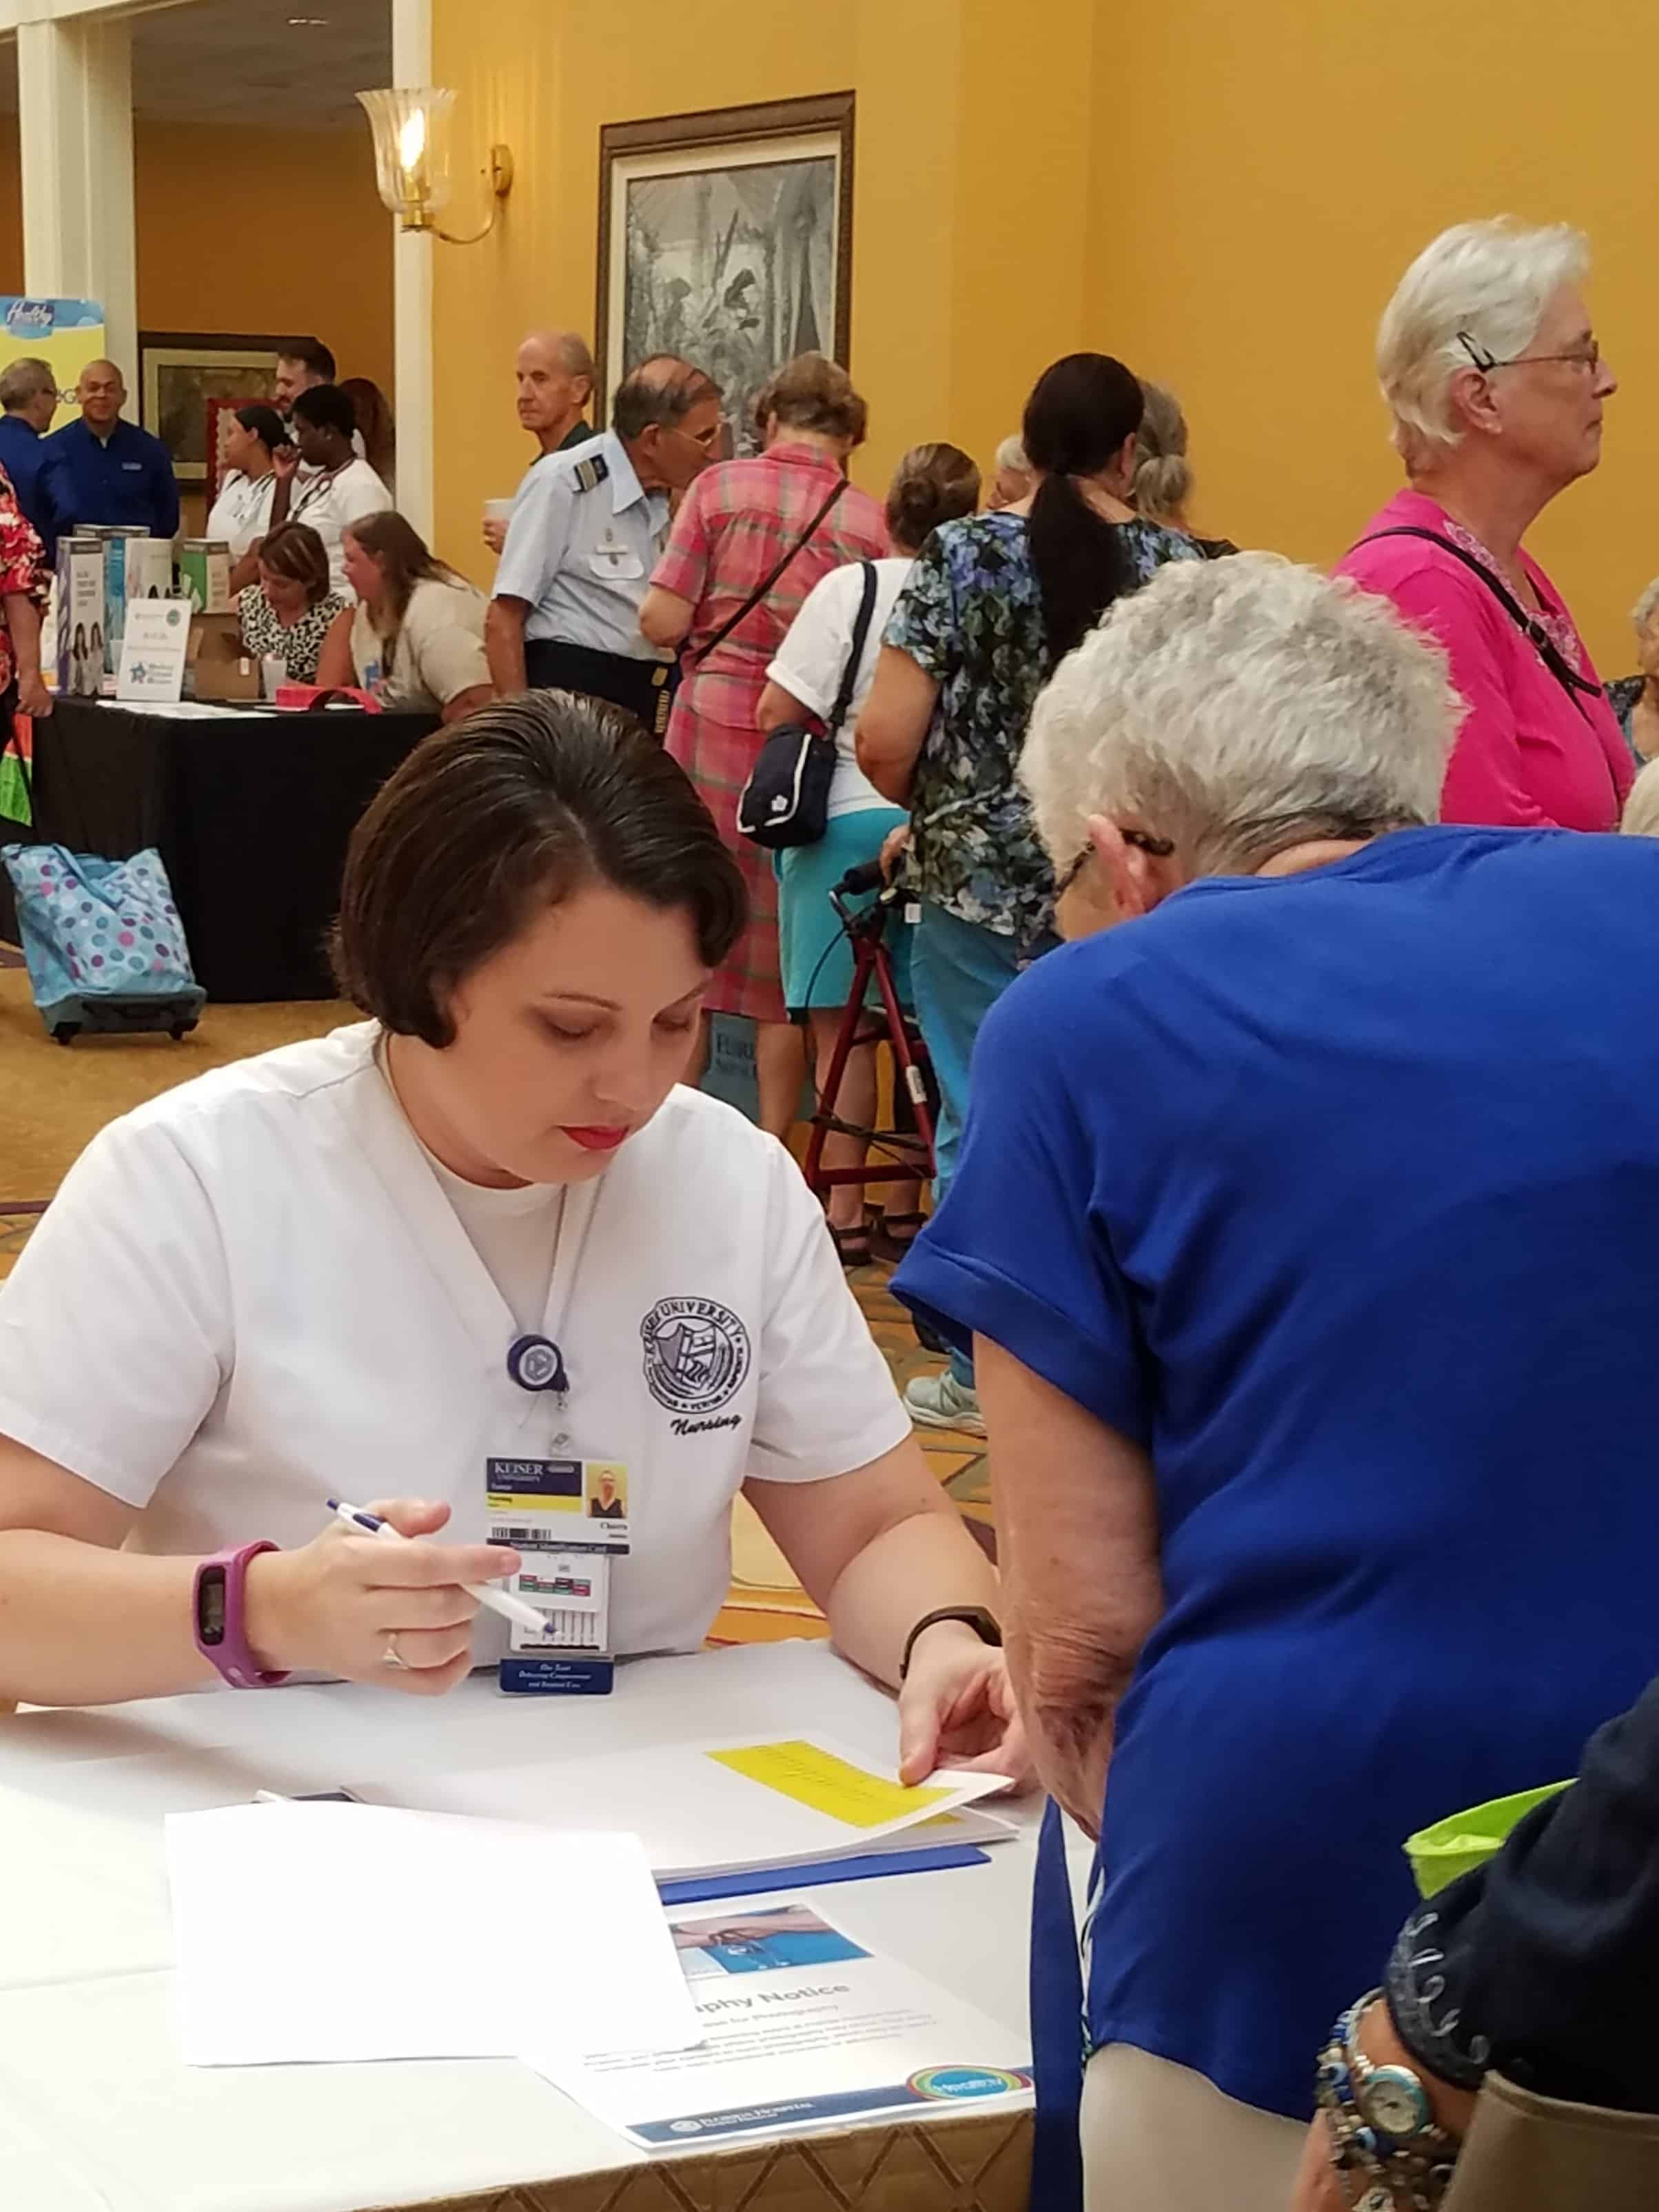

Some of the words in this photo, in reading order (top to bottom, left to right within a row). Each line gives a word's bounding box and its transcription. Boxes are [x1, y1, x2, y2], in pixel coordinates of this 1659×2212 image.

[660, 1301, 745, 1338] UNIVERSITY
[669, 1414, 742, 1436] Nursing
[494, 1461, 544, 1476] KEISER
[757, 1985, 851, 2004] Notice
